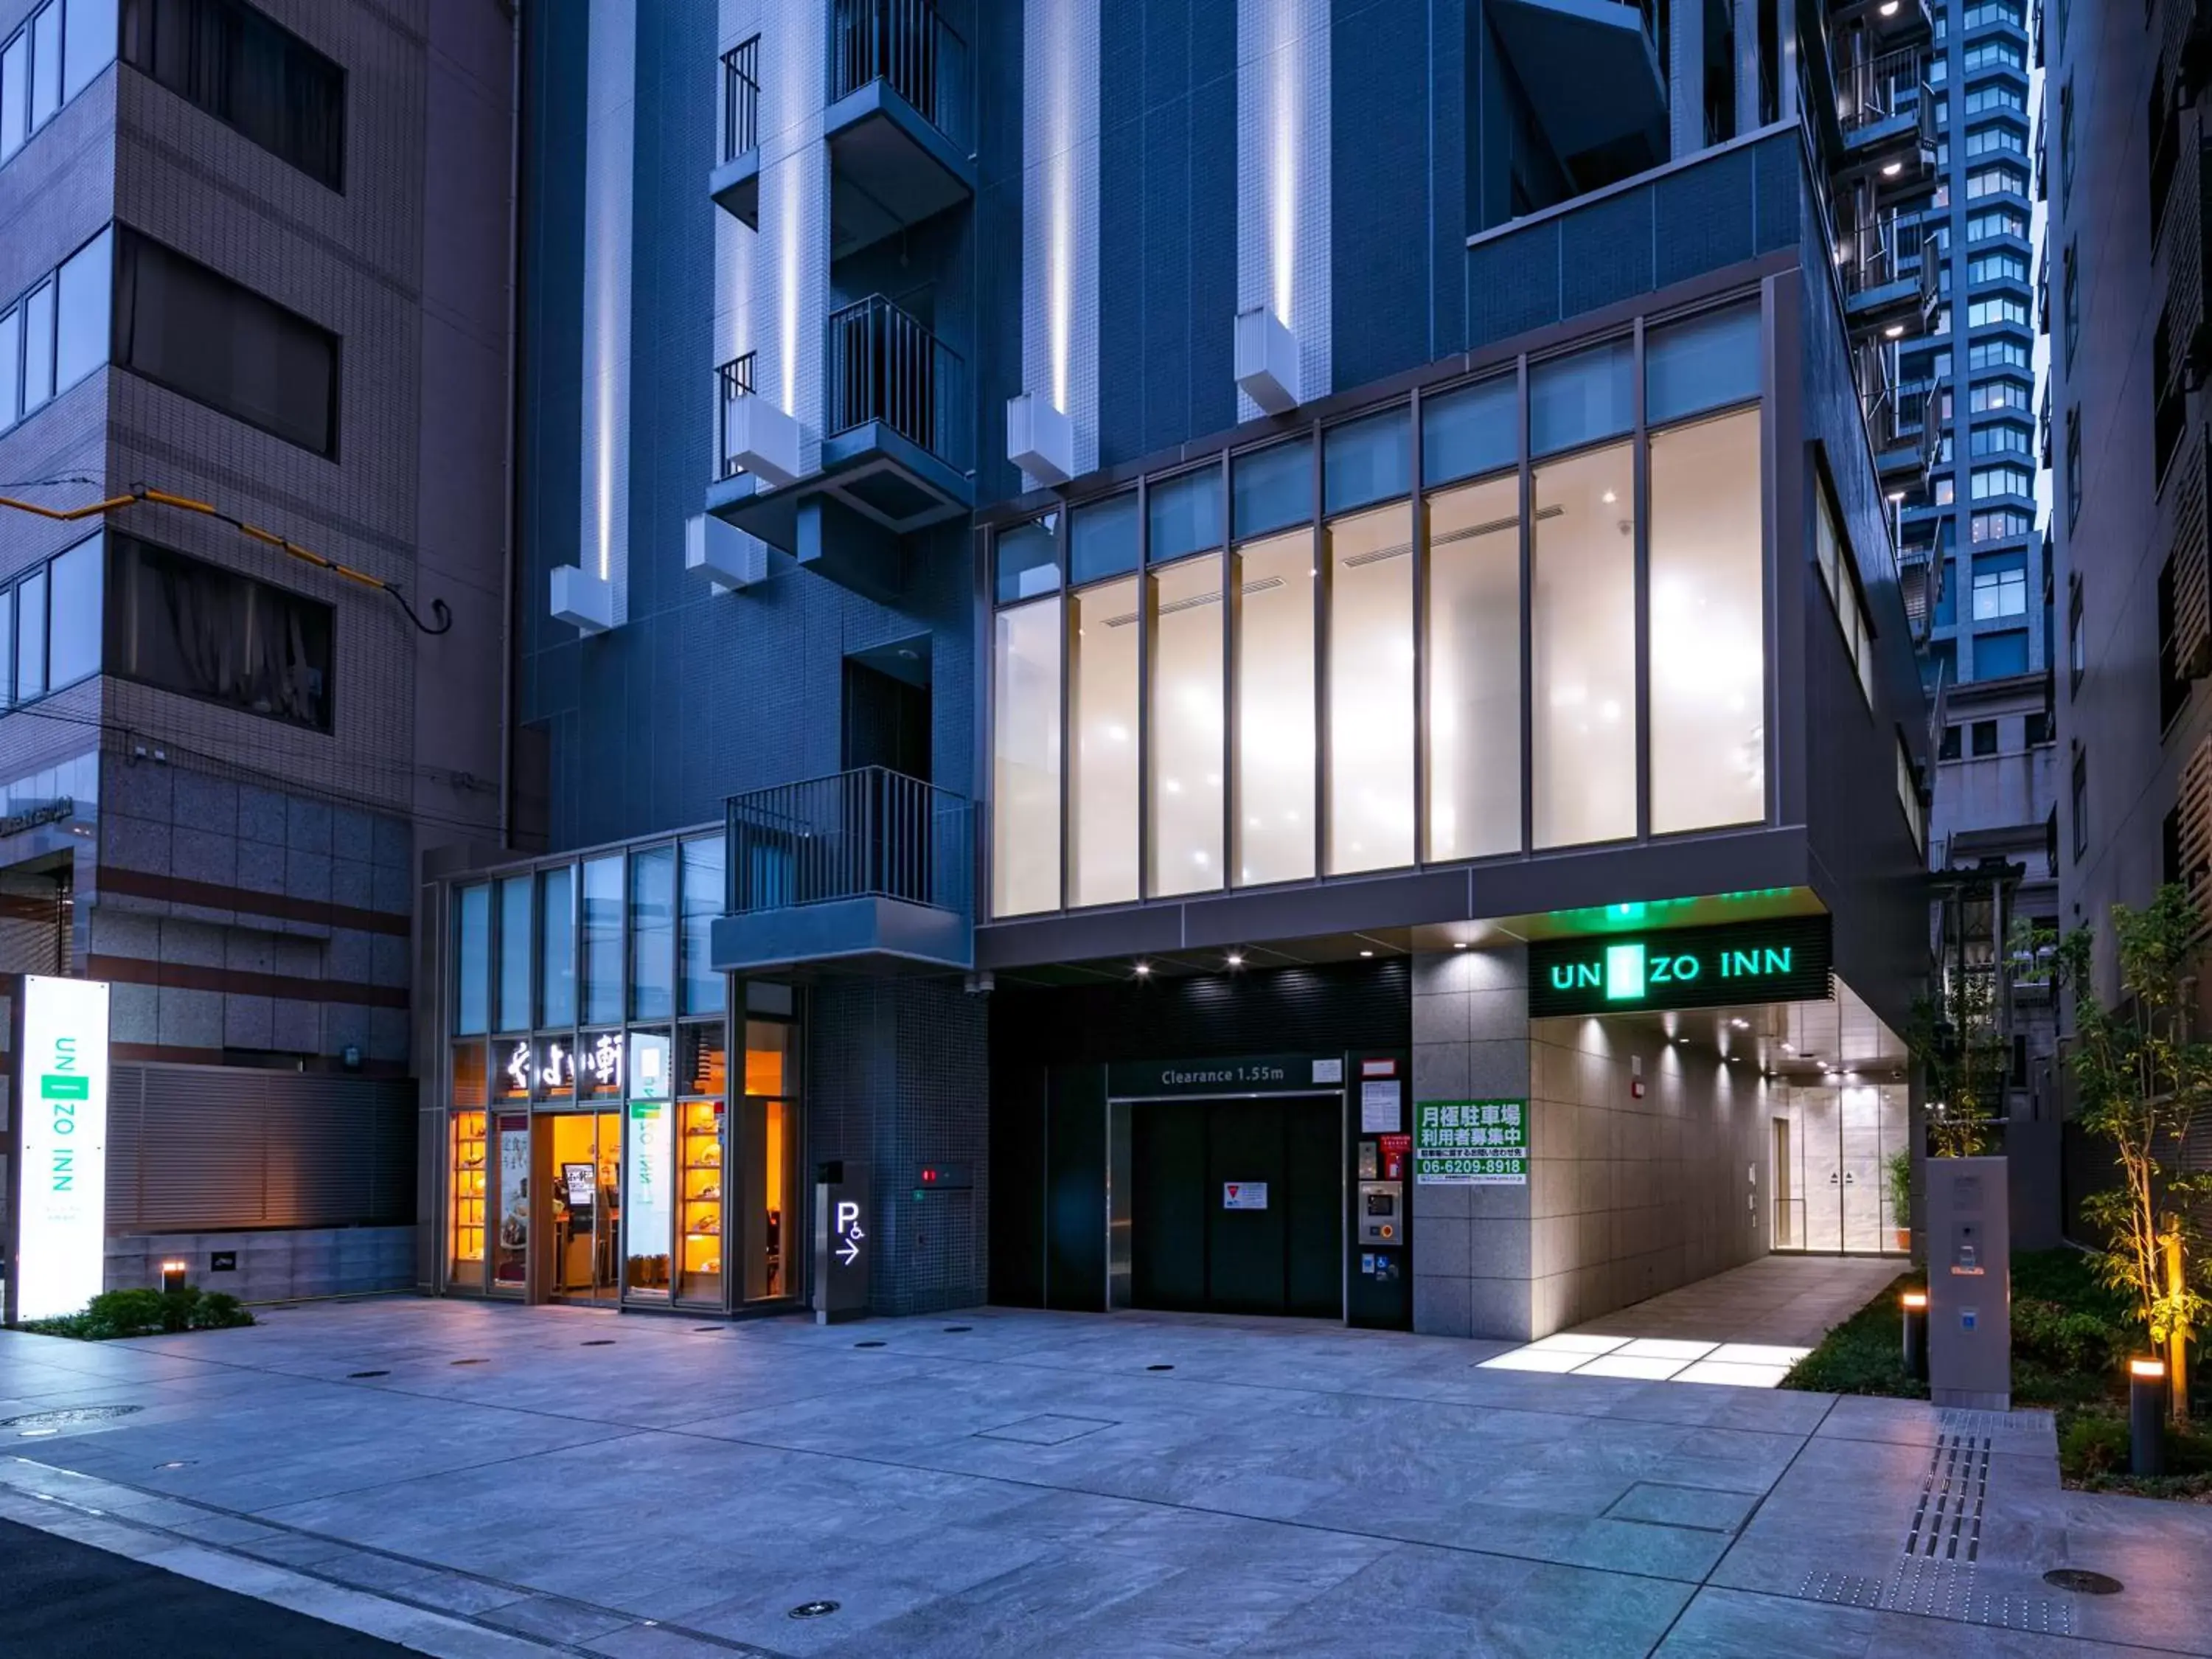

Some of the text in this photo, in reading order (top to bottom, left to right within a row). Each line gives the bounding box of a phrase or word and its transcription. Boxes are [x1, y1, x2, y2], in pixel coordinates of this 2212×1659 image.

[1721, 947, 1791, 977] INN
[507, 1035, 623, 1088] やよい軒
[1161, 1067, 1284, 1085] Clearance 1.55m
[41, 1037, 89, 1135] UNIZO
[1422, 1105, 1521, 1127] 月極駐車場
[1422, 1128, 1520, 1147] 利用者募集中
[52, 1150, 74, 1191] INN
[1423, 1160, 1520, 1173] 06-6209-8918
[837, 1202, 859, 1234] P
